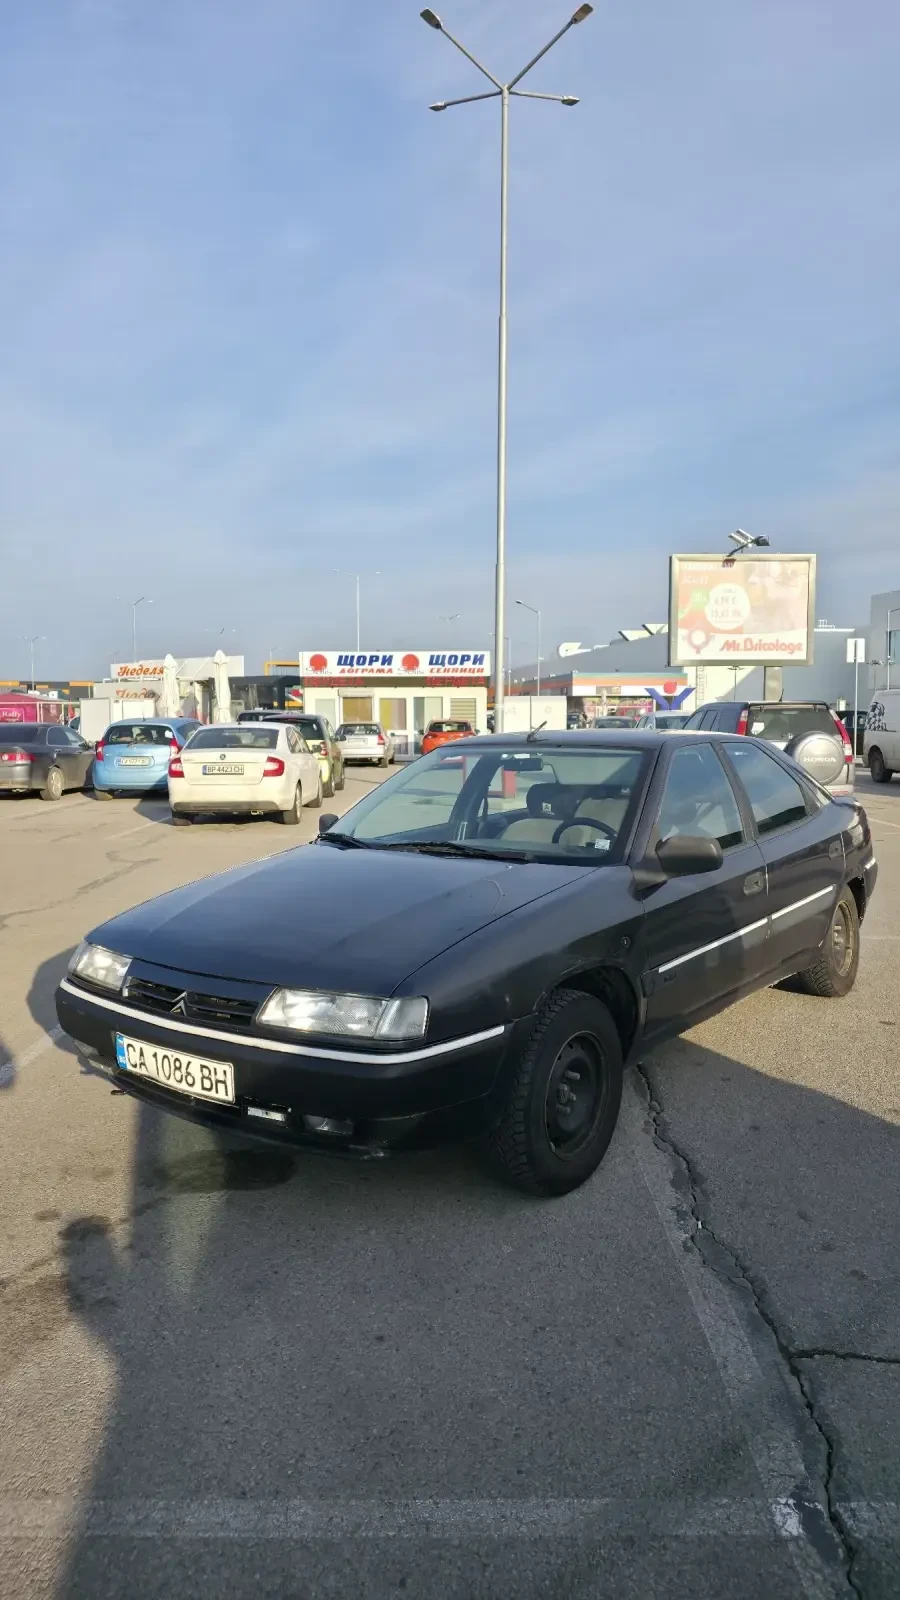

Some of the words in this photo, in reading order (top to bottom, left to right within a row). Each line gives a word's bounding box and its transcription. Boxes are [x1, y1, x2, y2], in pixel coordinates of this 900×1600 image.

[336, 654, 394, 667] ЩОРИ
[428, 654, 485, 667] ЩОРИ
[117, 664, 165, 677] Неделя
[126, 1043, 149, 1073] CA
[152, 1051, 195, 1088] 1086
[200, 1063, 229, 1097] BH
